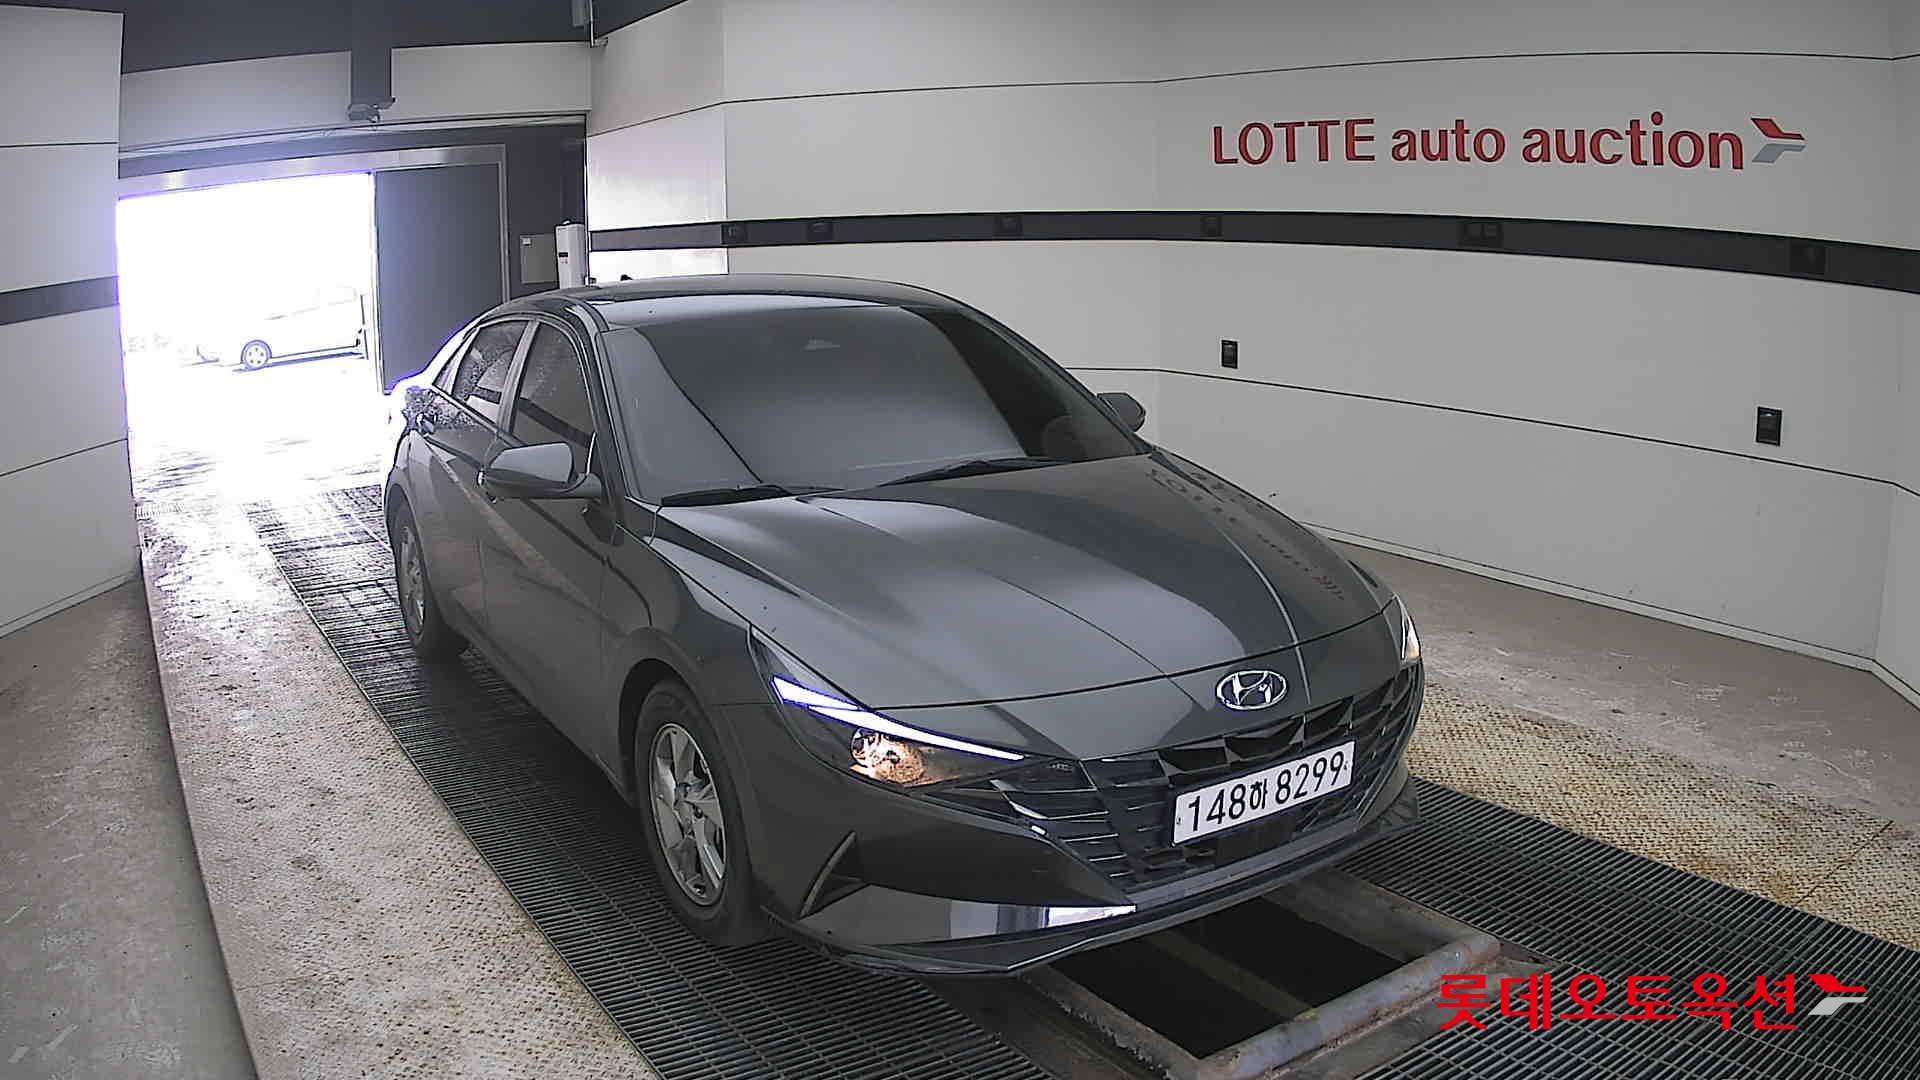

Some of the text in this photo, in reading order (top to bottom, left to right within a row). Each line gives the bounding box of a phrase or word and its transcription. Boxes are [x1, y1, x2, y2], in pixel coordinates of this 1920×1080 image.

[1212, 111, 1745, 171] LOTTE auto auction
[1188, 750, 1345, 832] 148하 8299
